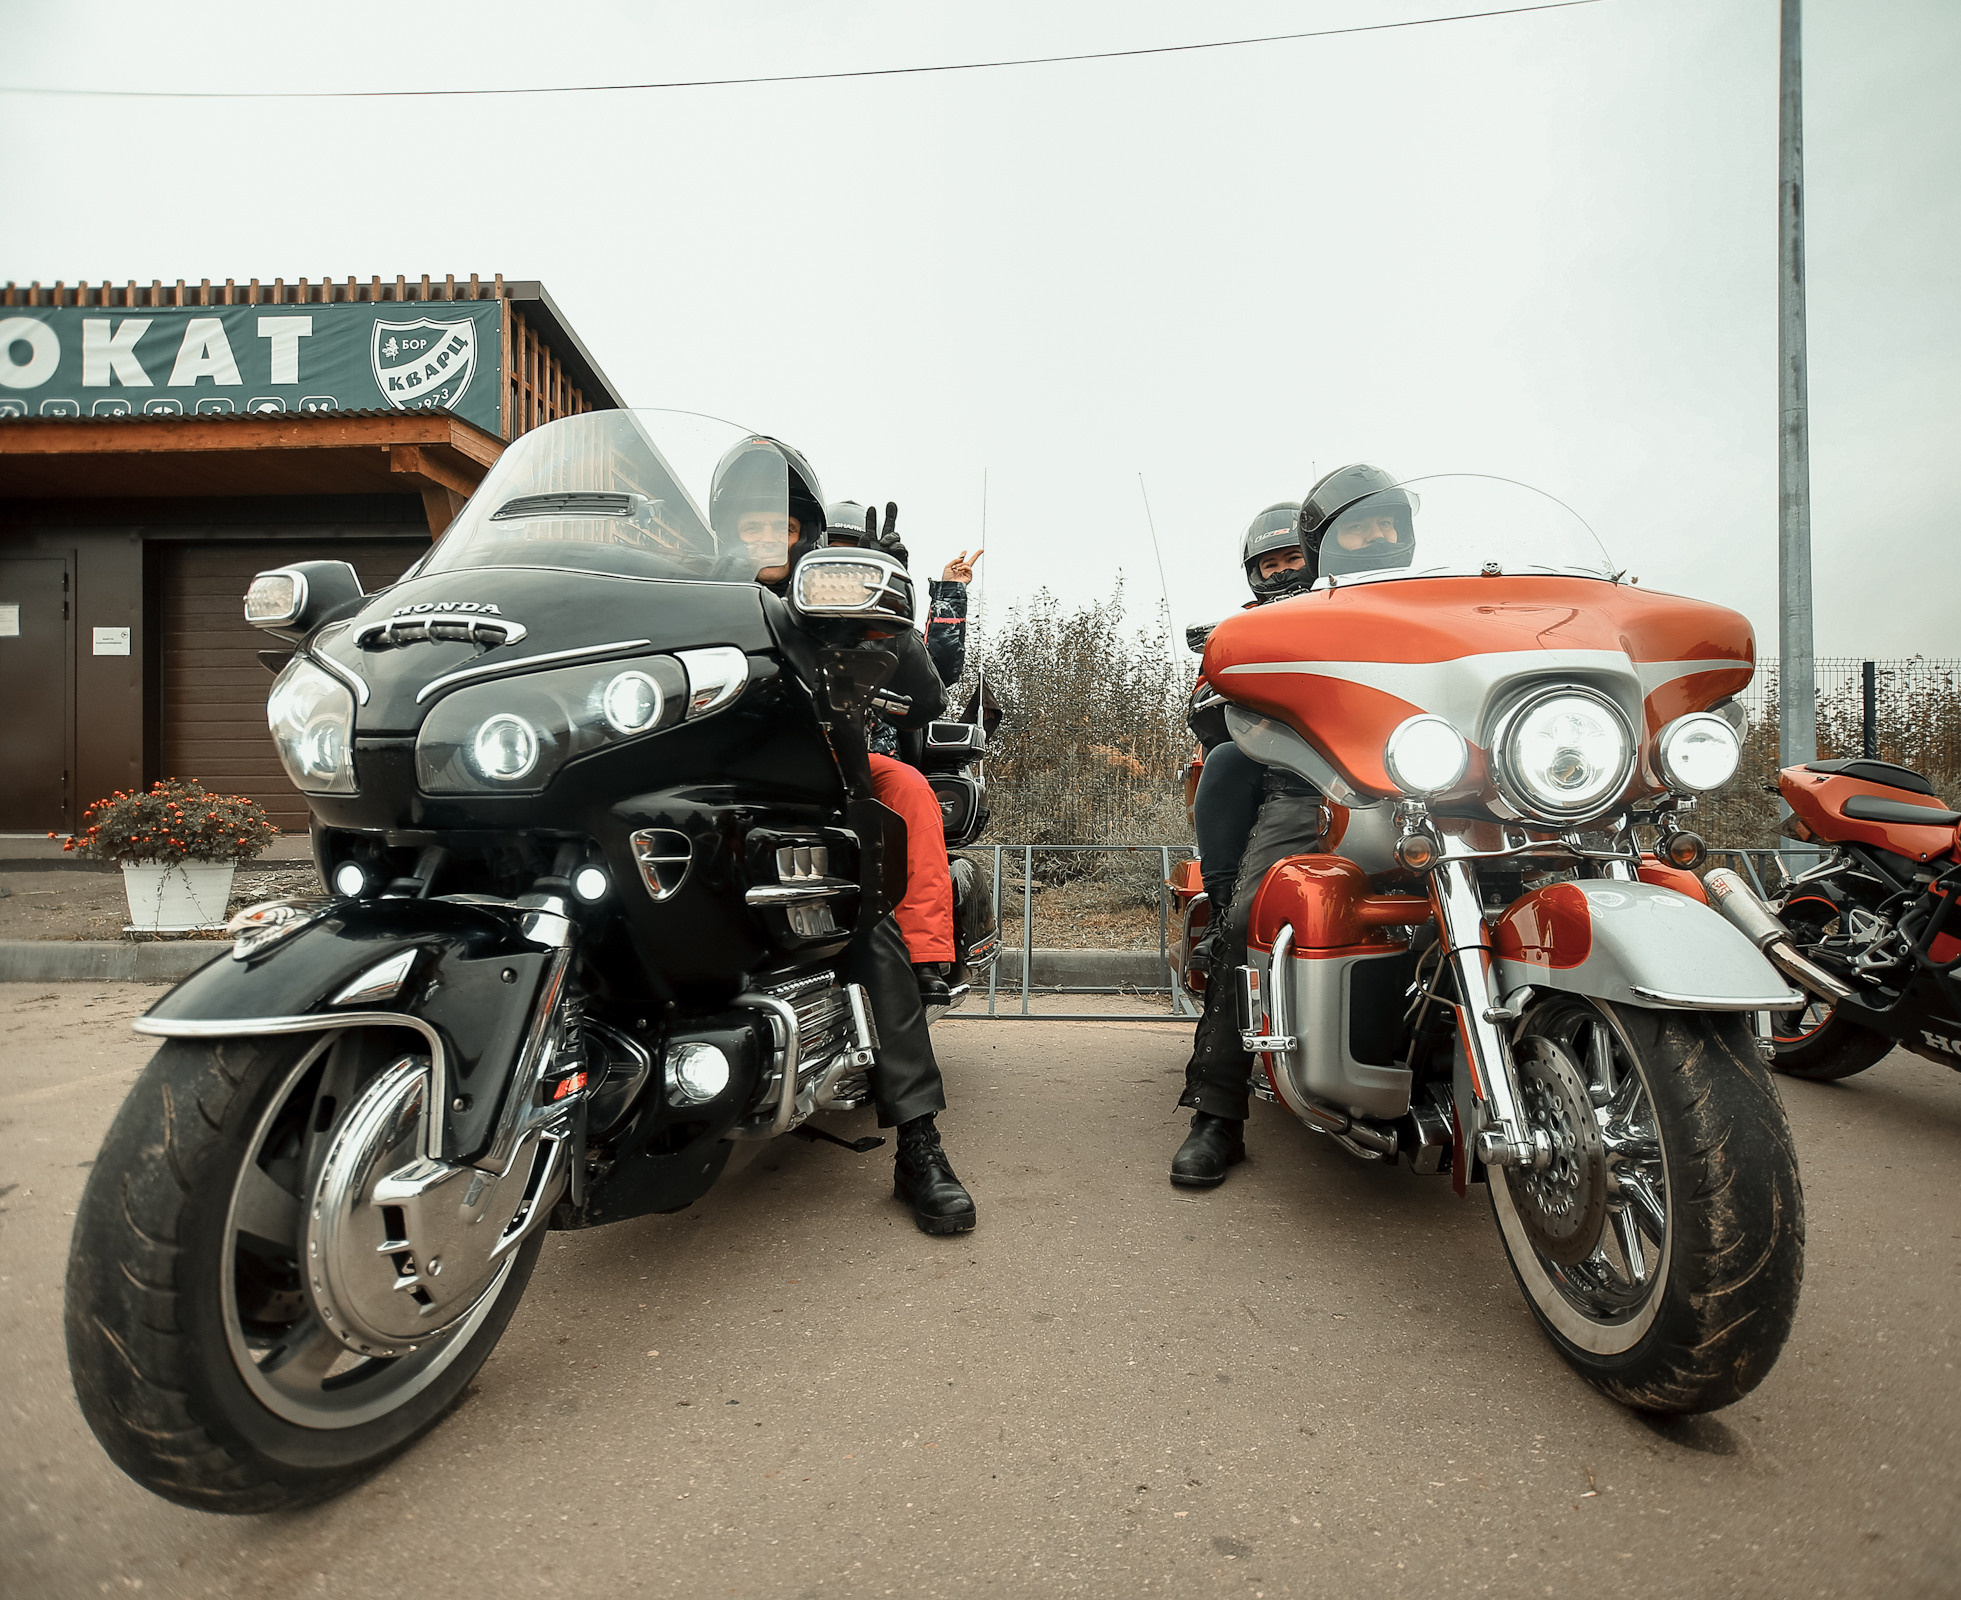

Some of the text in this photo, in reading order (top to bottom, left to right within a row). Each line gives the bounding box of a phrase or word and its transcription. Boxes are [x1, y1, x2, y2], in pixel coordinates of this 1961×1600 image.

[0, 316, 313, 388] ОКАТ
[402, 339, 427, 350] БОР
[388, 335, 469, 392] КВАРЦ
[392, 602, 502, 616] HONDA
